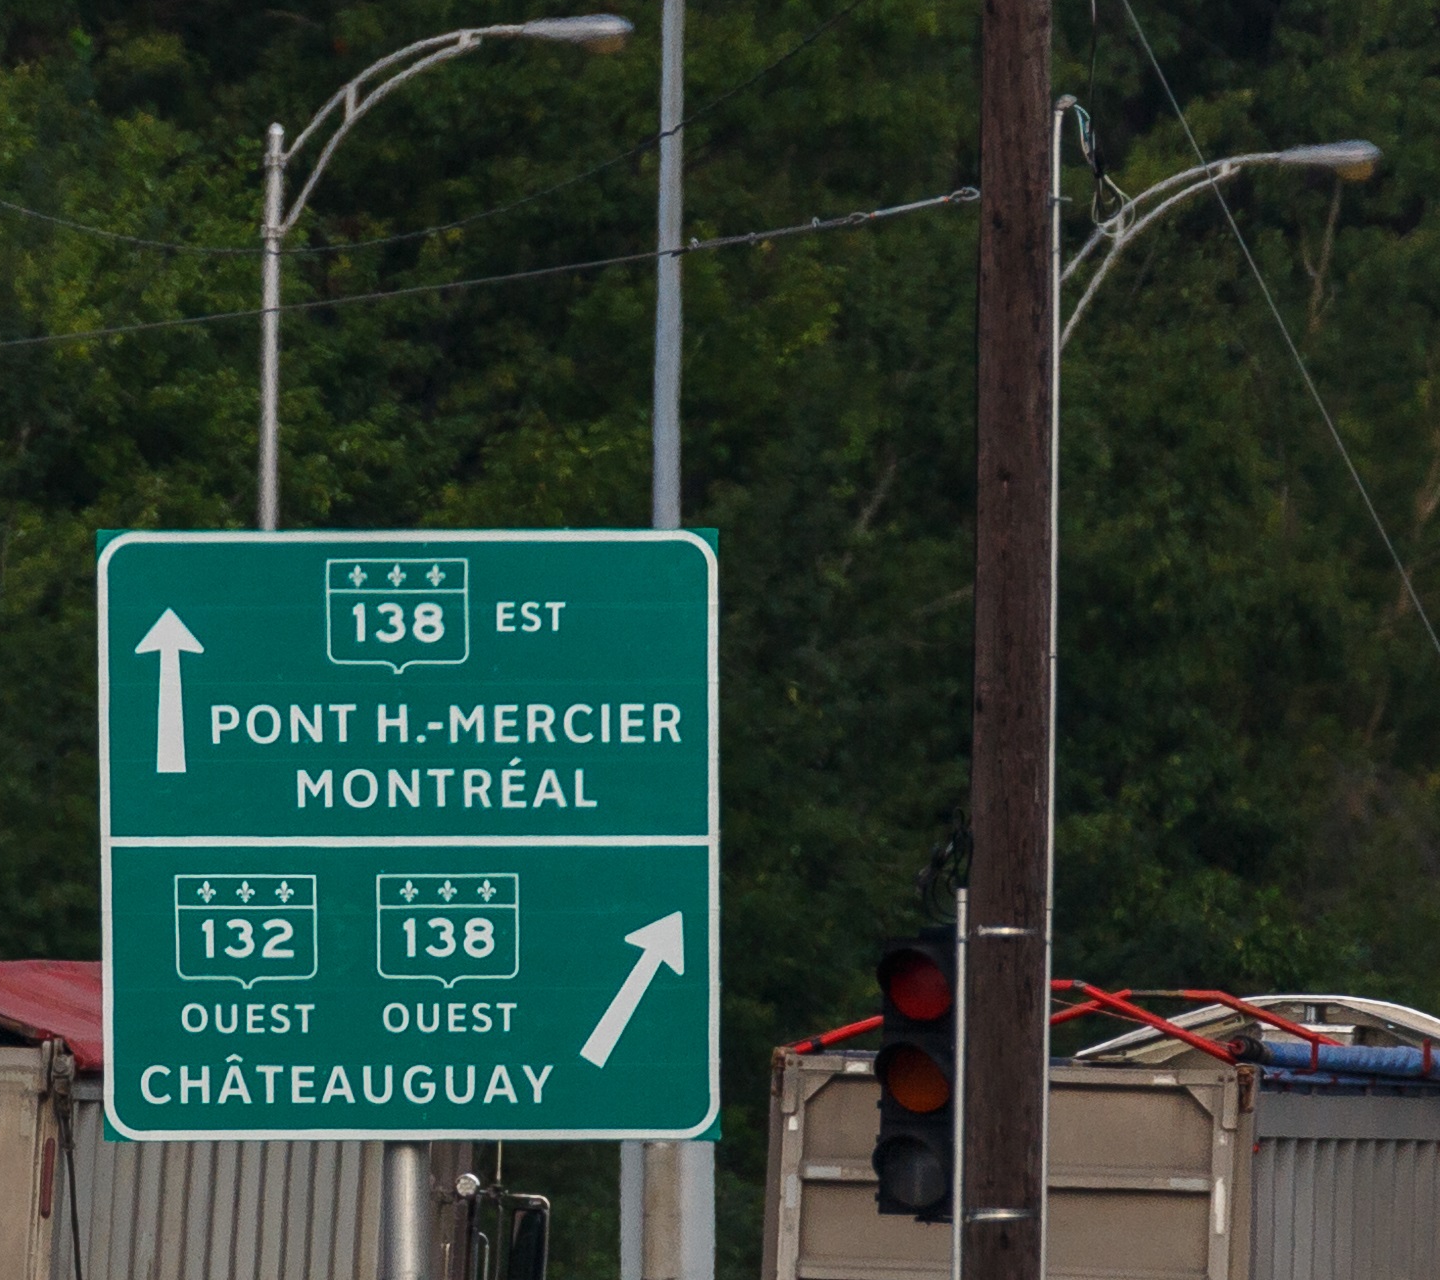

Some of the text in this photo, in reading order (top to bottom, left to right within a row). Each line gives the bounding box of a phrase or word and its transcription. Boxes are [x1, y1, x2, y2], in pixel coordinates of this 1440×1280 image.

[352, 601, 566, 643] 138 EST
[211, 703, 681, 745] PONT H.-MERCIER
[297, 757, 597, 809] MONTRÉAL
[201, 917, 495, 959] 132 138
[181, 1002, 517, 1034] OUEST OUEST
[140, 1053, 553, 1105] CHÂTEAUGUAY
